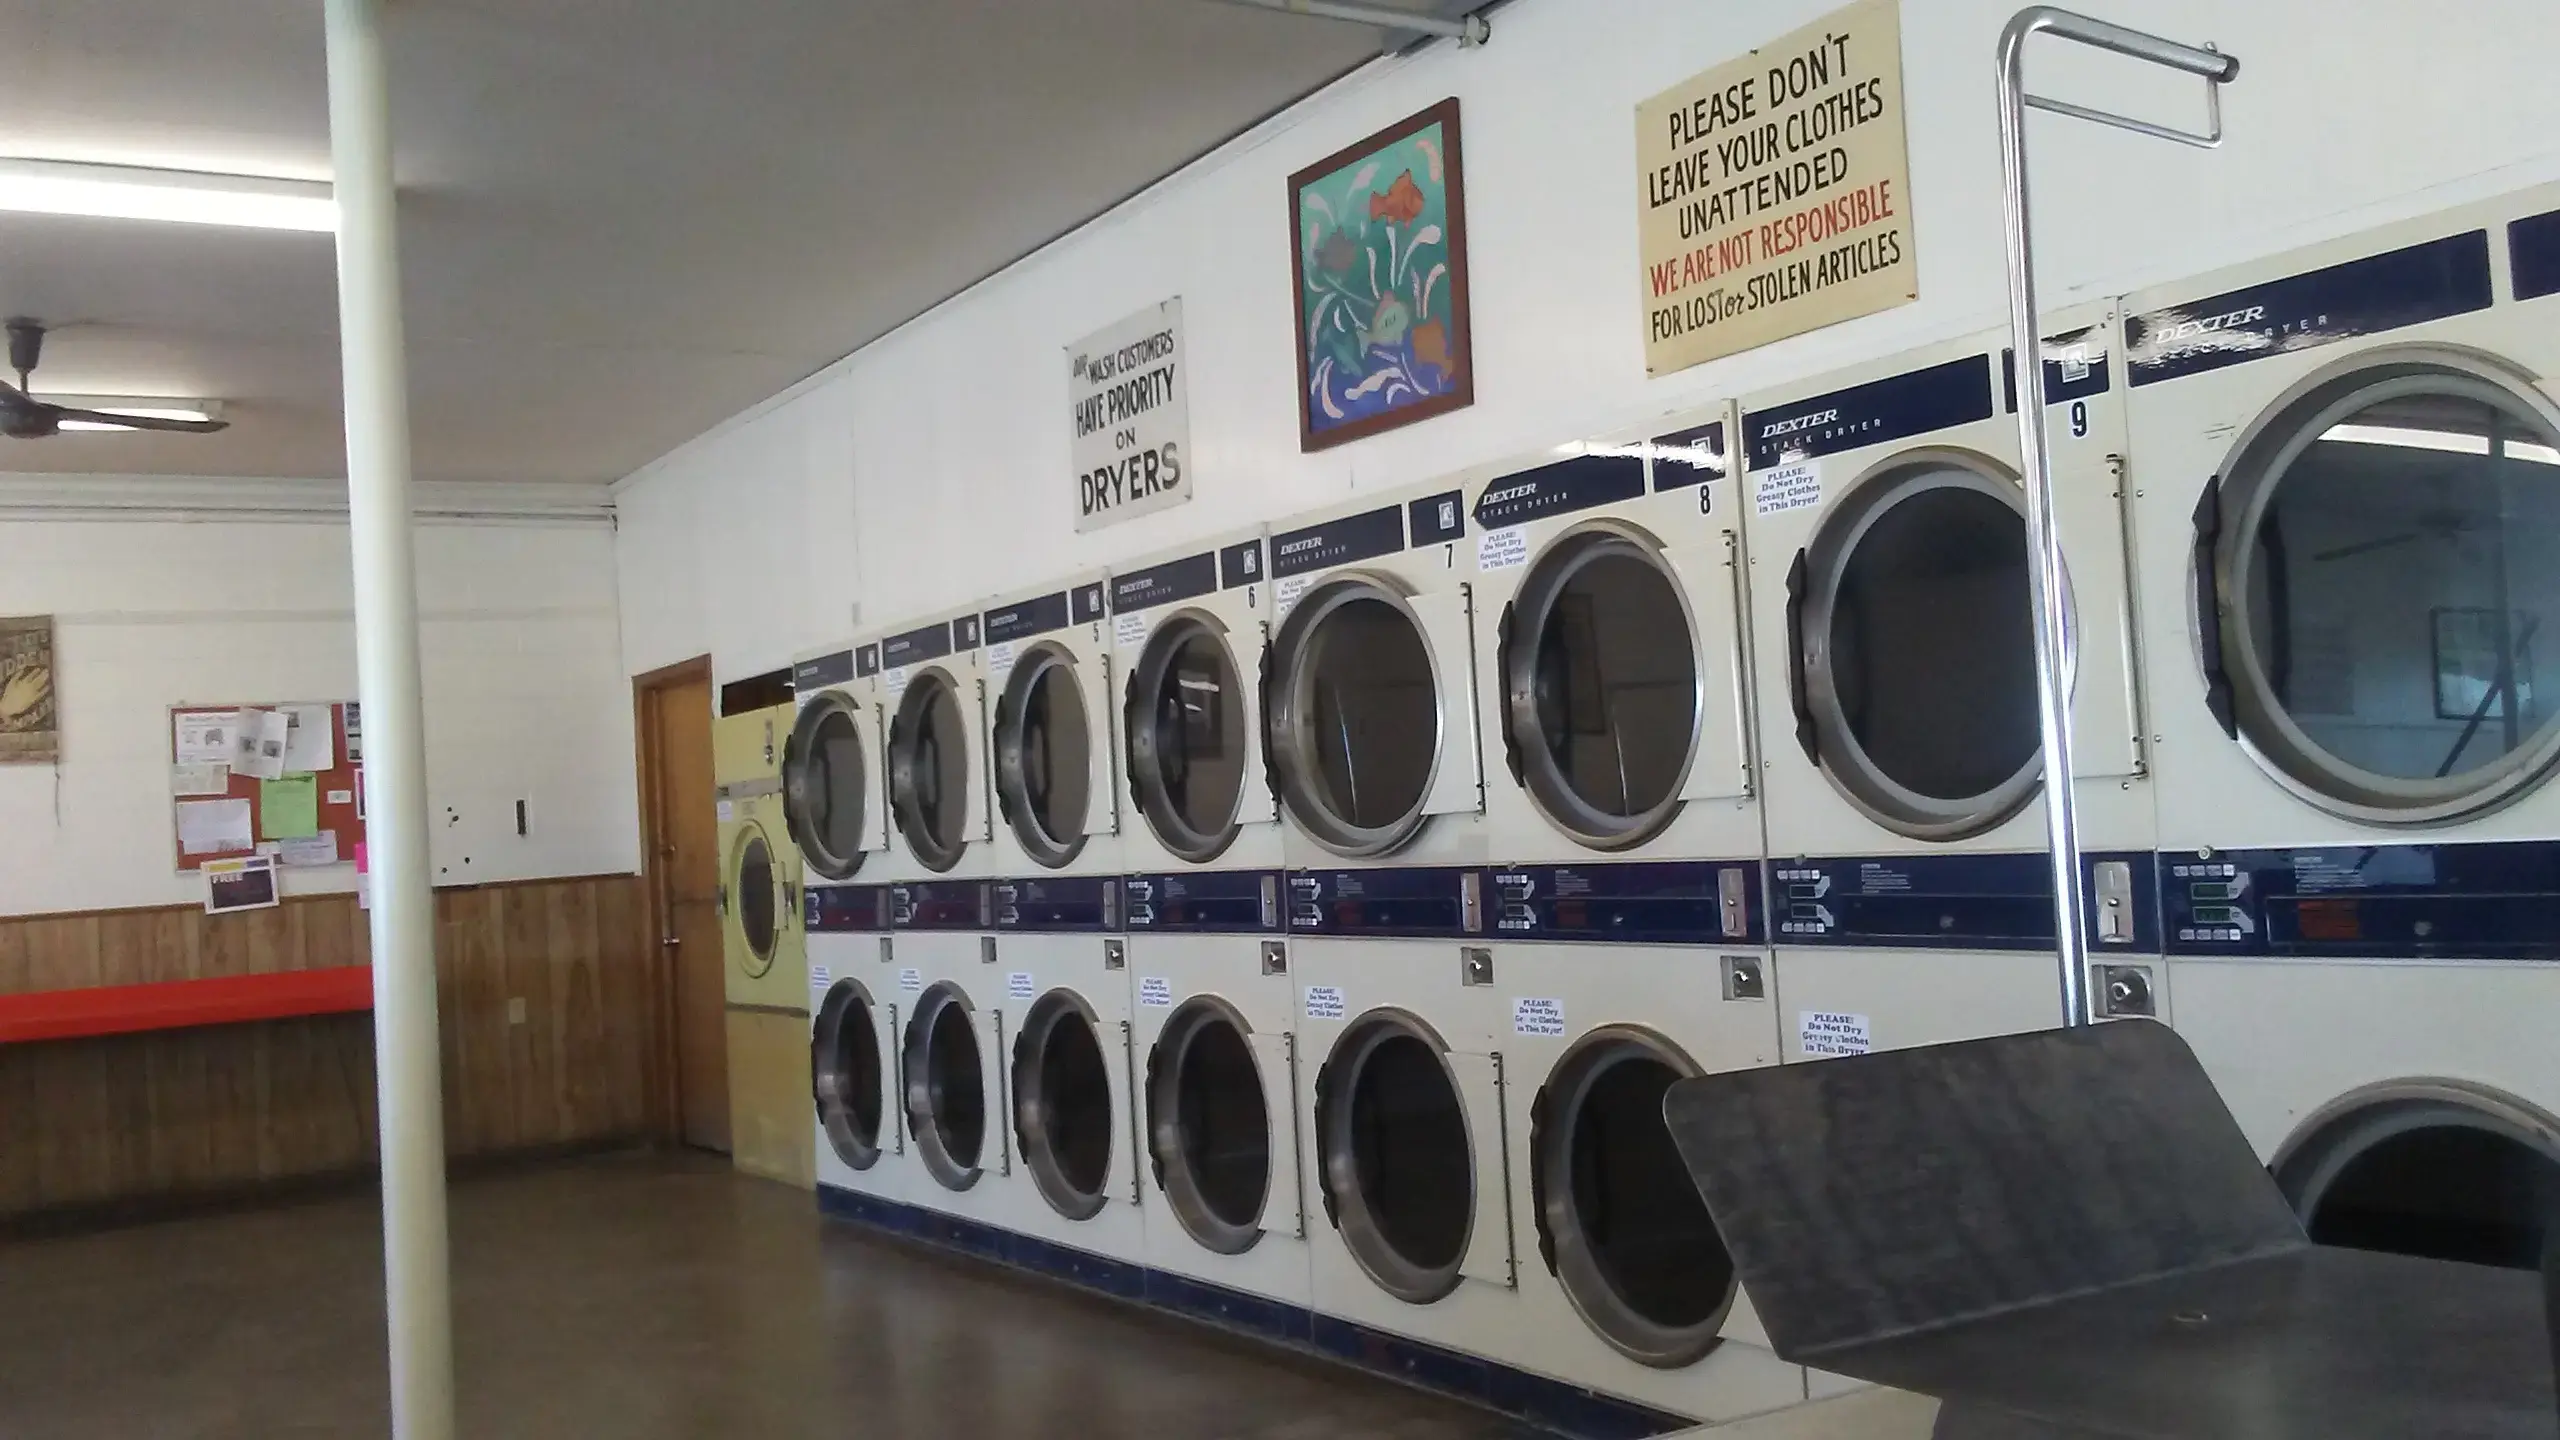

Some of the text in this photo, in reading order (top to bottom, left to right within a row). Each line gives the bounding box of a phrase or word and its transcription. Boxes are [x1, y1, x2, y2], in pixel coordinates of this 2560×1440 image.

[1669, 33, 1849, 150] PLEASE DON'T
[1649, 77, 1883, 209] LEAVE YOUR CLOTHES
[1679, 147, 1848, 239] UNATTENDED
[1650, 179, 1893, 298] WE ARE NOT RESPONSIBLE
[1652, 303, 1683, 343] FOR
[1747, 261, 1812, 311] STOLEN
[1816, 230, 1901, 290] ARTICLES
[2155, 305, 2265, 344] DEXTER
[1089, 353, 1117, 386] WASH
[1118, 328, 1174, 374] CUSTOMERS
[1075, 363, 1175, 438] HAVE PRIORITY
[1761, 408, 1839, 439] DEXTER
[2072, 401, 2087, 437] 9
[1115, 427, 1136, 450] ON
[1761, 418, 1882, 455] STACK DRYER
[1080, 442, 1181, 516] DRYERS
[1776, 479, 1793, 488] Not
[1796, 476, 1814, 484] Dry
[1788, 484, 1820, 496] Clothes
[1482, 483, 1536, 506] DEXTER
[1700, 485, 1711, 515] 8
[1769, 501, 1788, 511] This
[1280, 536, 1322, 555] DEXTER
[1445, 543, 1453, 568] 7
[1248, 586, 1255, 608] 6
[211, 872, 244, 884] FREE
[1545, 1008, 1558, 1016] Dry
[1808, 1022, 1862, 1035] Do Not Dry
